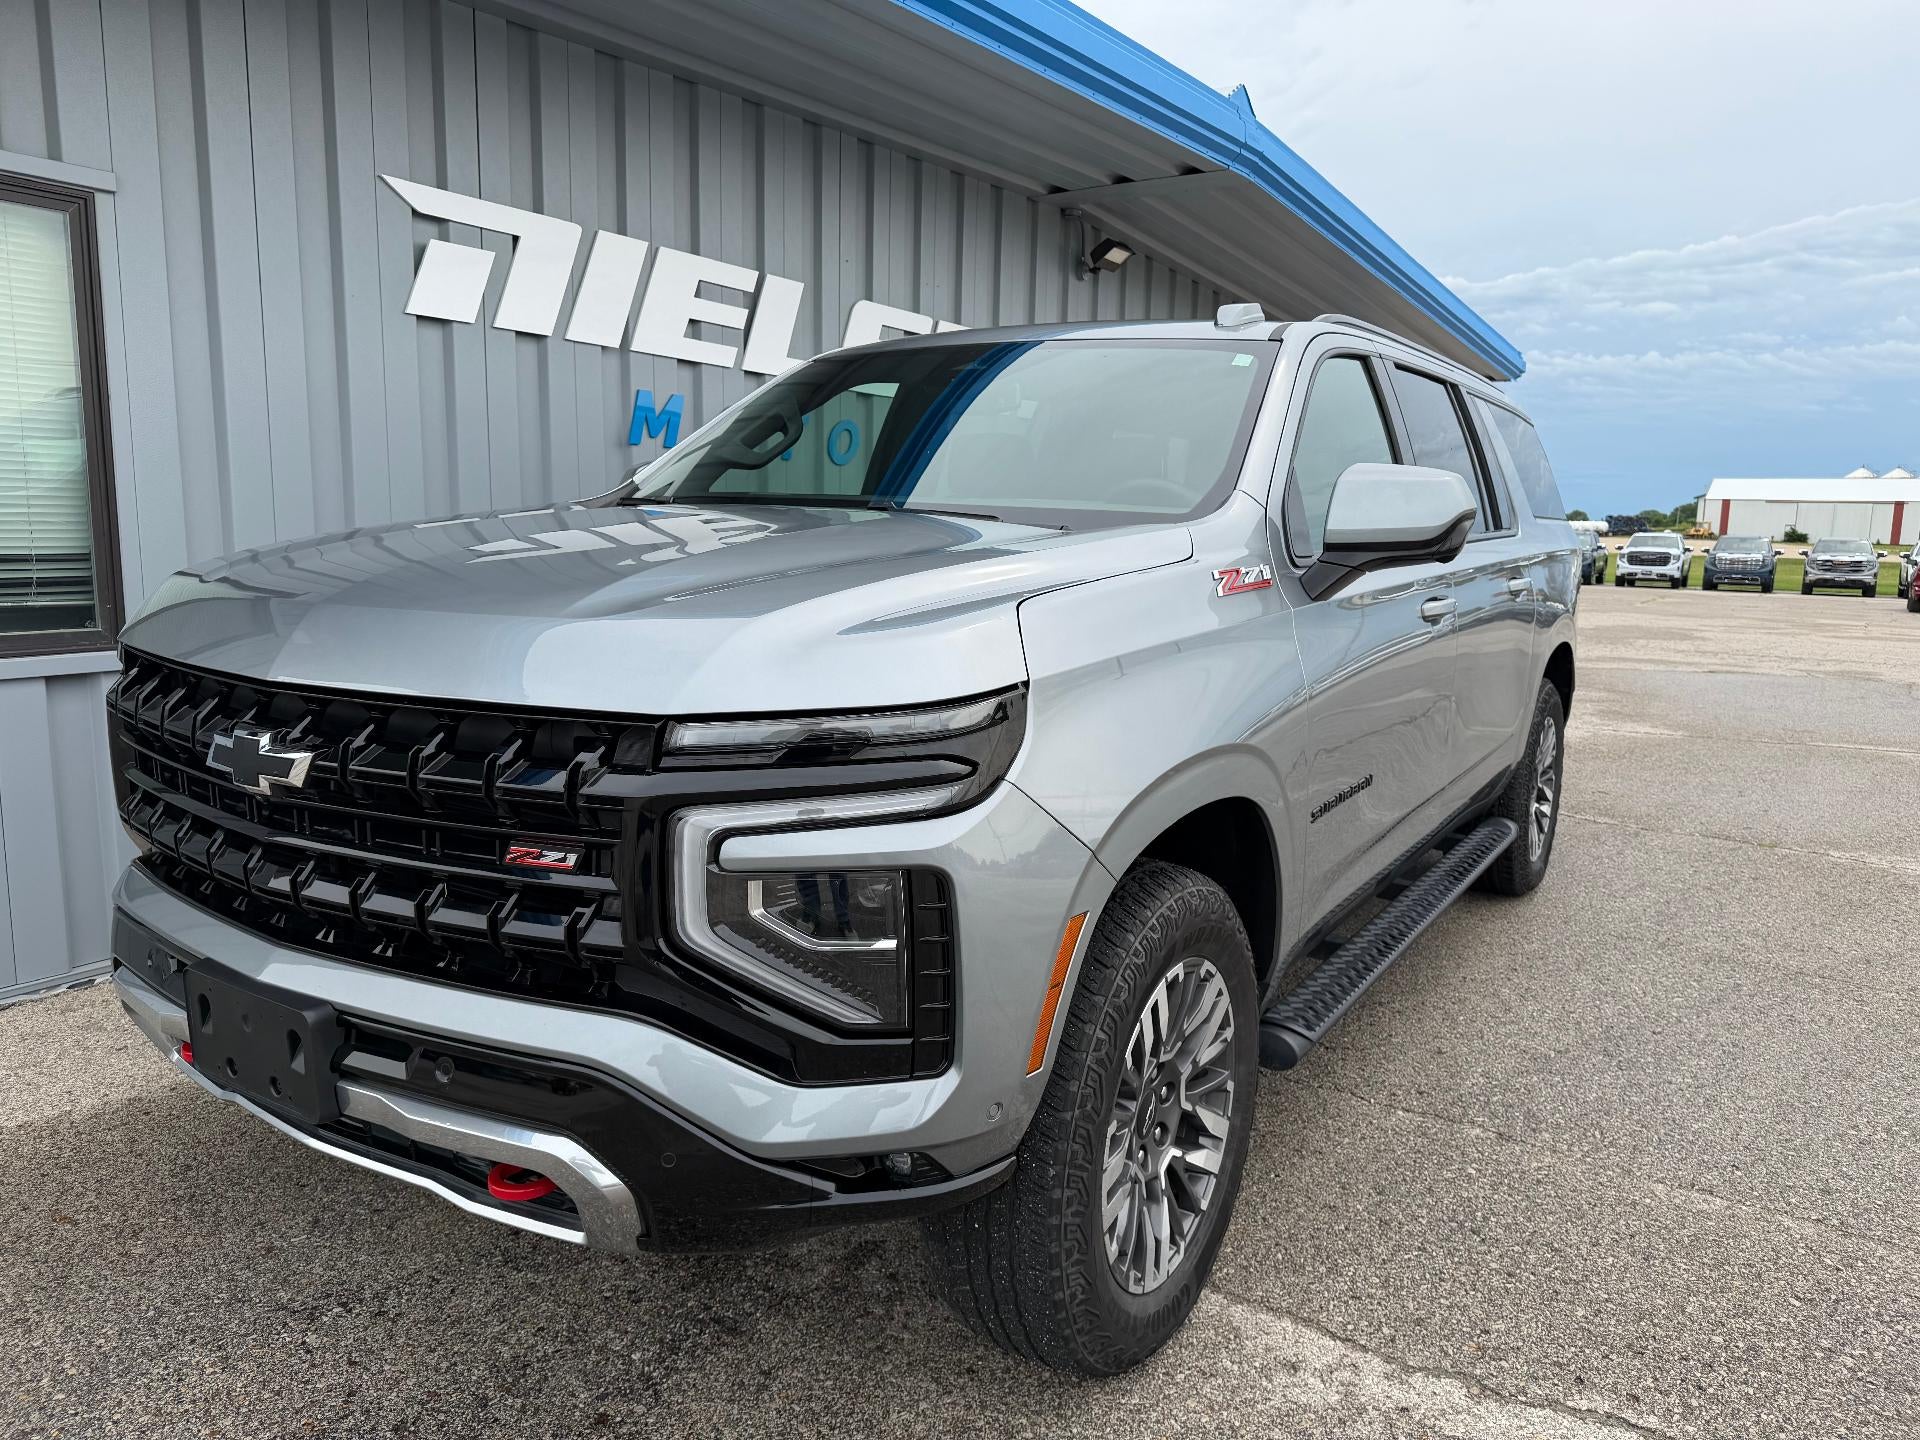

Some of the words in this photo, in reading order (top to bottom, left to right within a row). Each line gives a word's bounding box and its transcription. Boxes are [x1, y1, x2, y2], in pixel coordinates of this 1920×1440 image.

[1211, 564, 1273, 597] Z71
[1310, 773, 1374, 824] SUBURBAN
[505, 846, 579, 870] Z71
